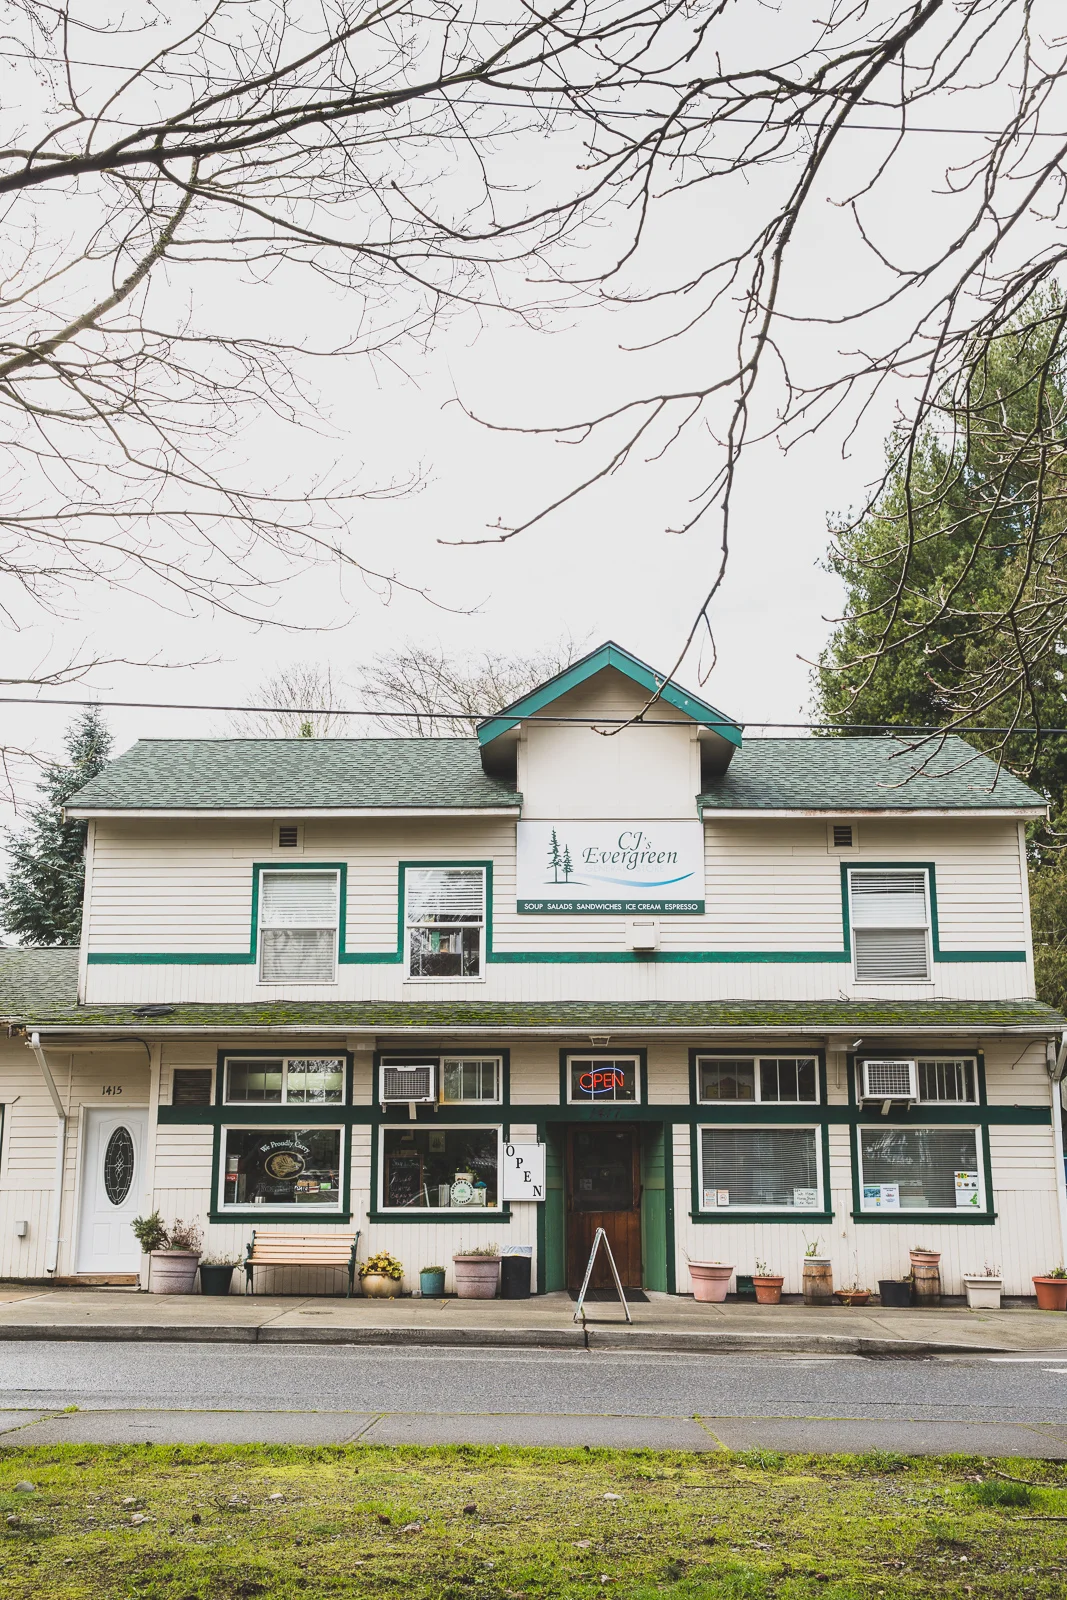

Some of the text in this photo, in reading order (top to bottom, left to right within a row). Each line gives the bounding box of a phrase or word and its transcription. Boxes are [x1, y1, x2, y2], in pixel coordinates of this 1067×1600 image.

[617, 831, 652, 851] CJ's
[582, 847, 678, 870] Evergreen
[524, 903, 698, 911] SOUP SALADS SANDWICHES ICE CREAM ESPRESSO
[579, 1072, 624, 1088] OPEN
[102, 1085, 123, 1096] 1415
[260, 1139, 311, 1154] We Proudly Carry
[505, 1145, 542, 1197] OPEN
